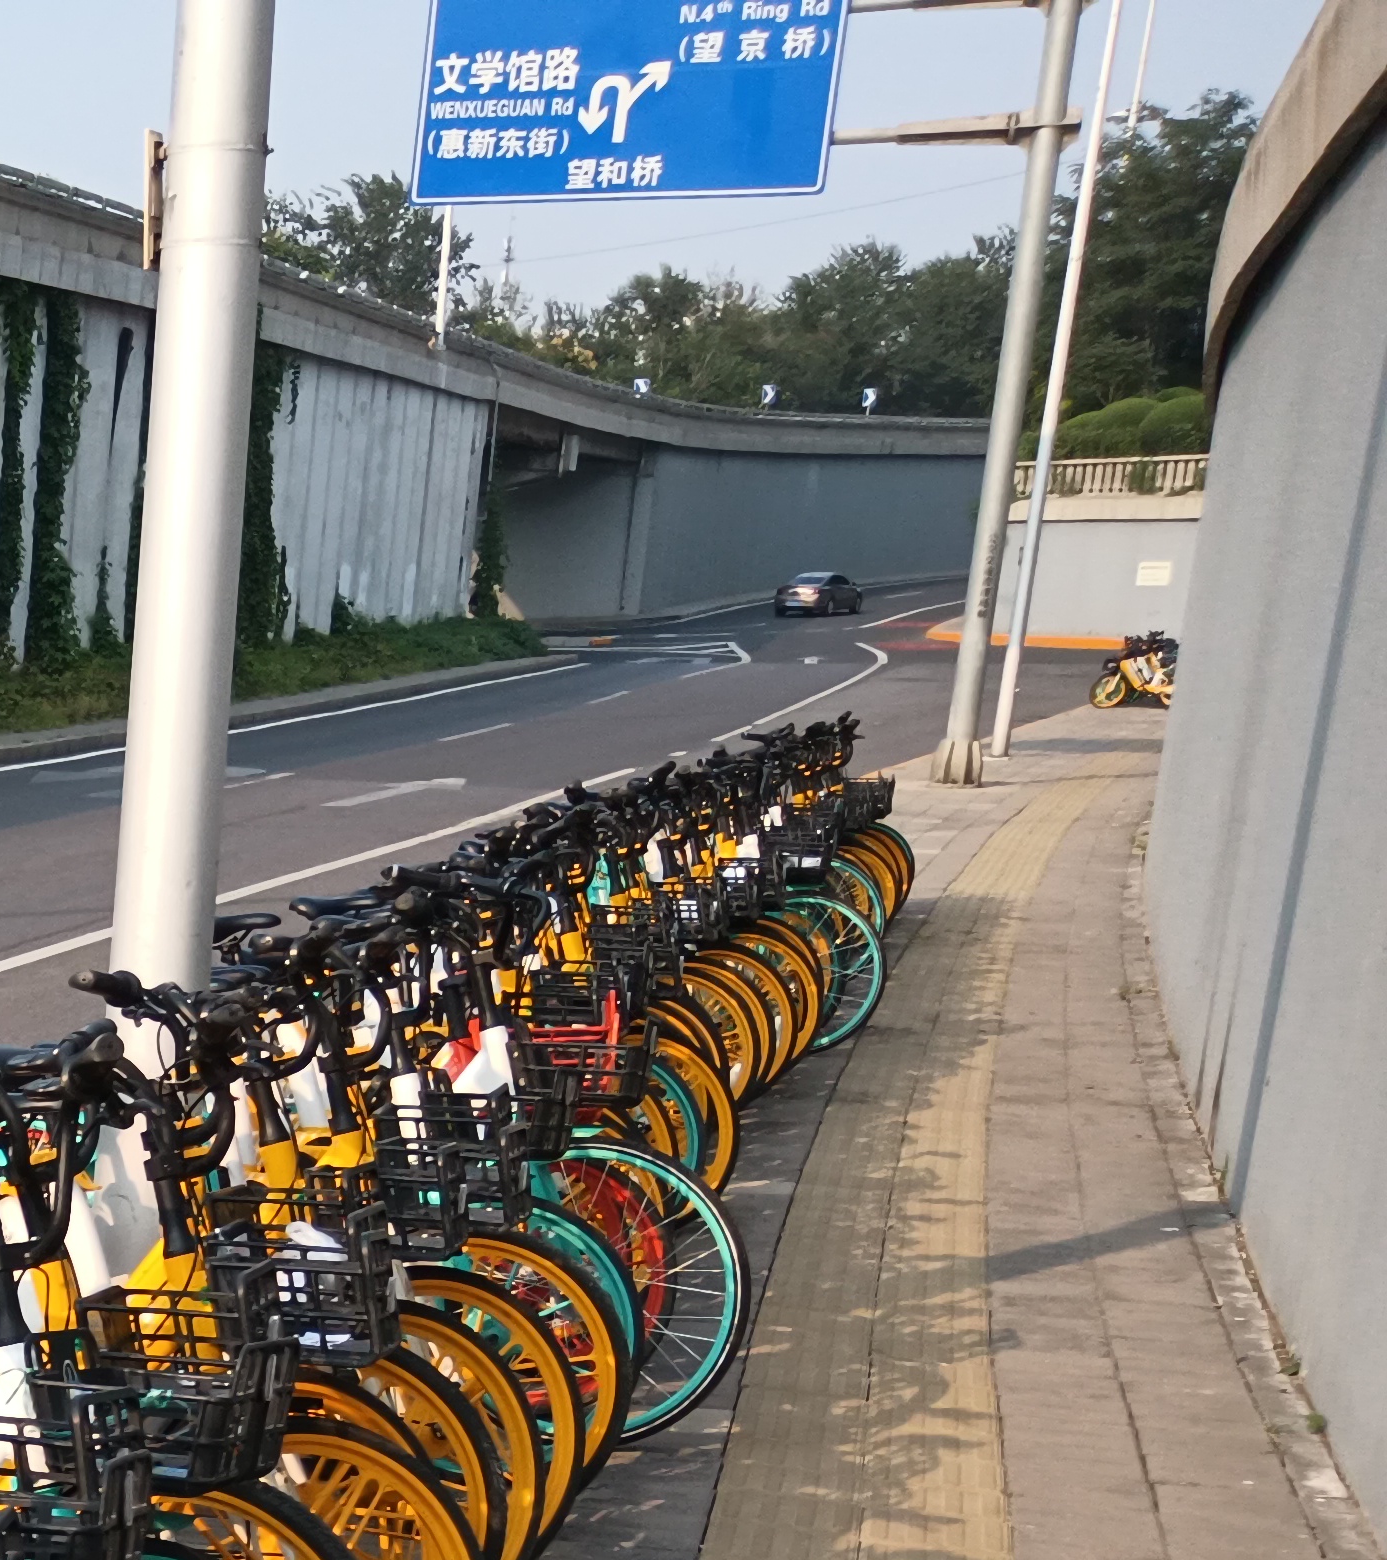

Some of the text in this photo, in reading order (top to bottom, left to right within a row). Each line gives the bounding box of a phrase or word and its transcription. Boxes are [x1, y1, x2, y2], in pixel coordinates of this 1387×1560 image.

[741, 0, 789, 22] Ring
[800, 0, 830, 17] Rd
[433, 46, 580, 95] 文学馆路
[430, 96, 575, 120] WENXUEGUAN Rd
[564, 154, 663, 189] 望和桥
